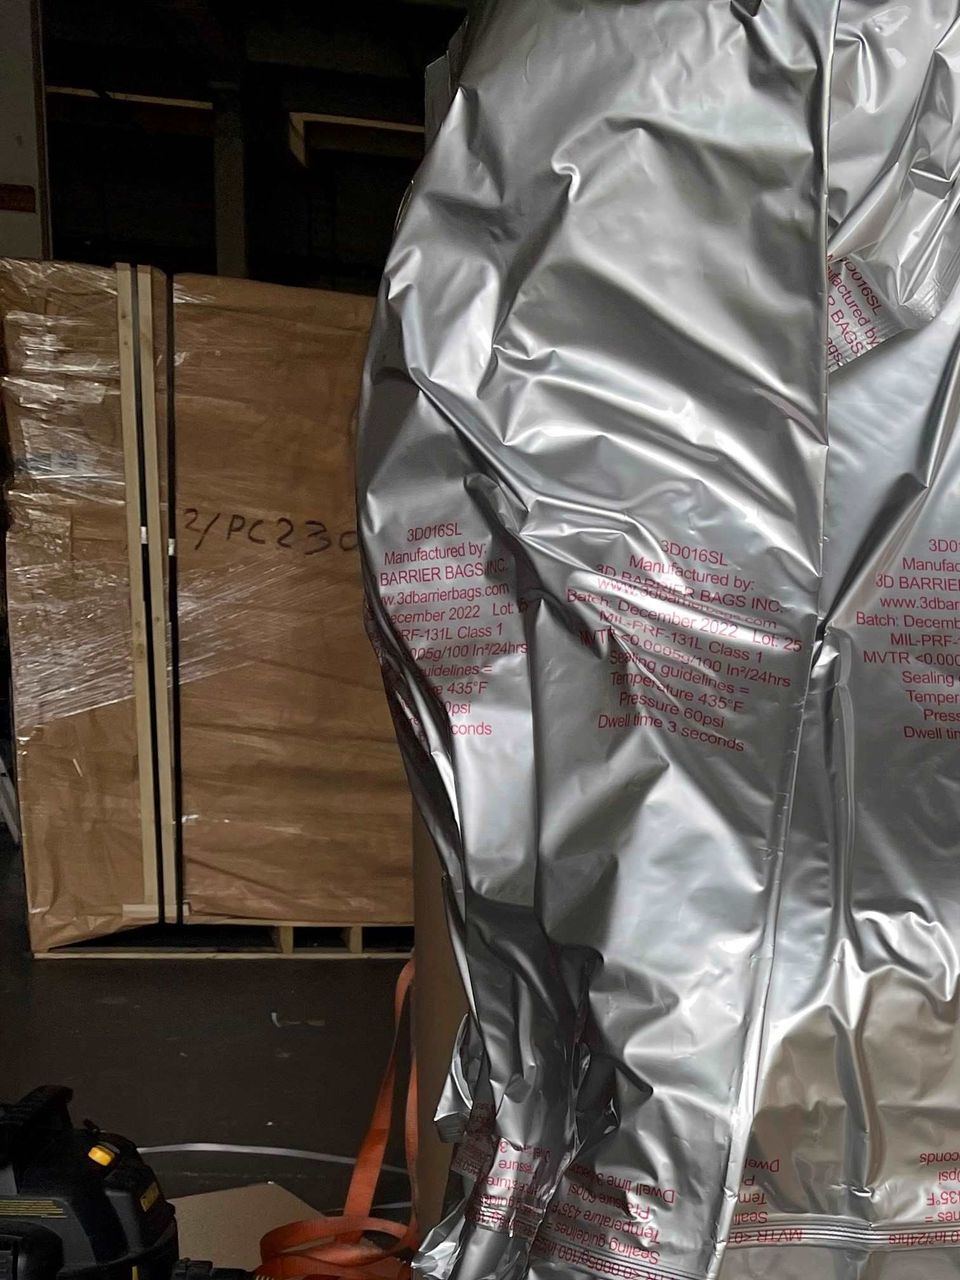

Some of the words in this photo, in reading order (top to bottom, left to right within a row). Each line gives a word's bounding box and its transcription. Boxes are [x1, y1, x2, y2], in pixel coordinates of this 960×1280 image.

[384, 544, 465, 565] Manufactured
[661, 540, 729, 566] 3D016SL
[380, 567, 441, 585] BARRIER
[445, 563, 484, 579] BAGS
[629, 555, 729, 585] Manufactured
[875, 573, 895, 589] 3D
[700, 590, 746, 608] BAGS
[449, 605, 480, 619] 2022
[618, 599, 696, 628] December
[709, 642, 749, 660] Class
[783, 638, 802, 652] 25
[863, 650, 910, 666] MVTR
[902, 670, 955, 690] Sealing
[903, 725, 942, 740] Dwell
